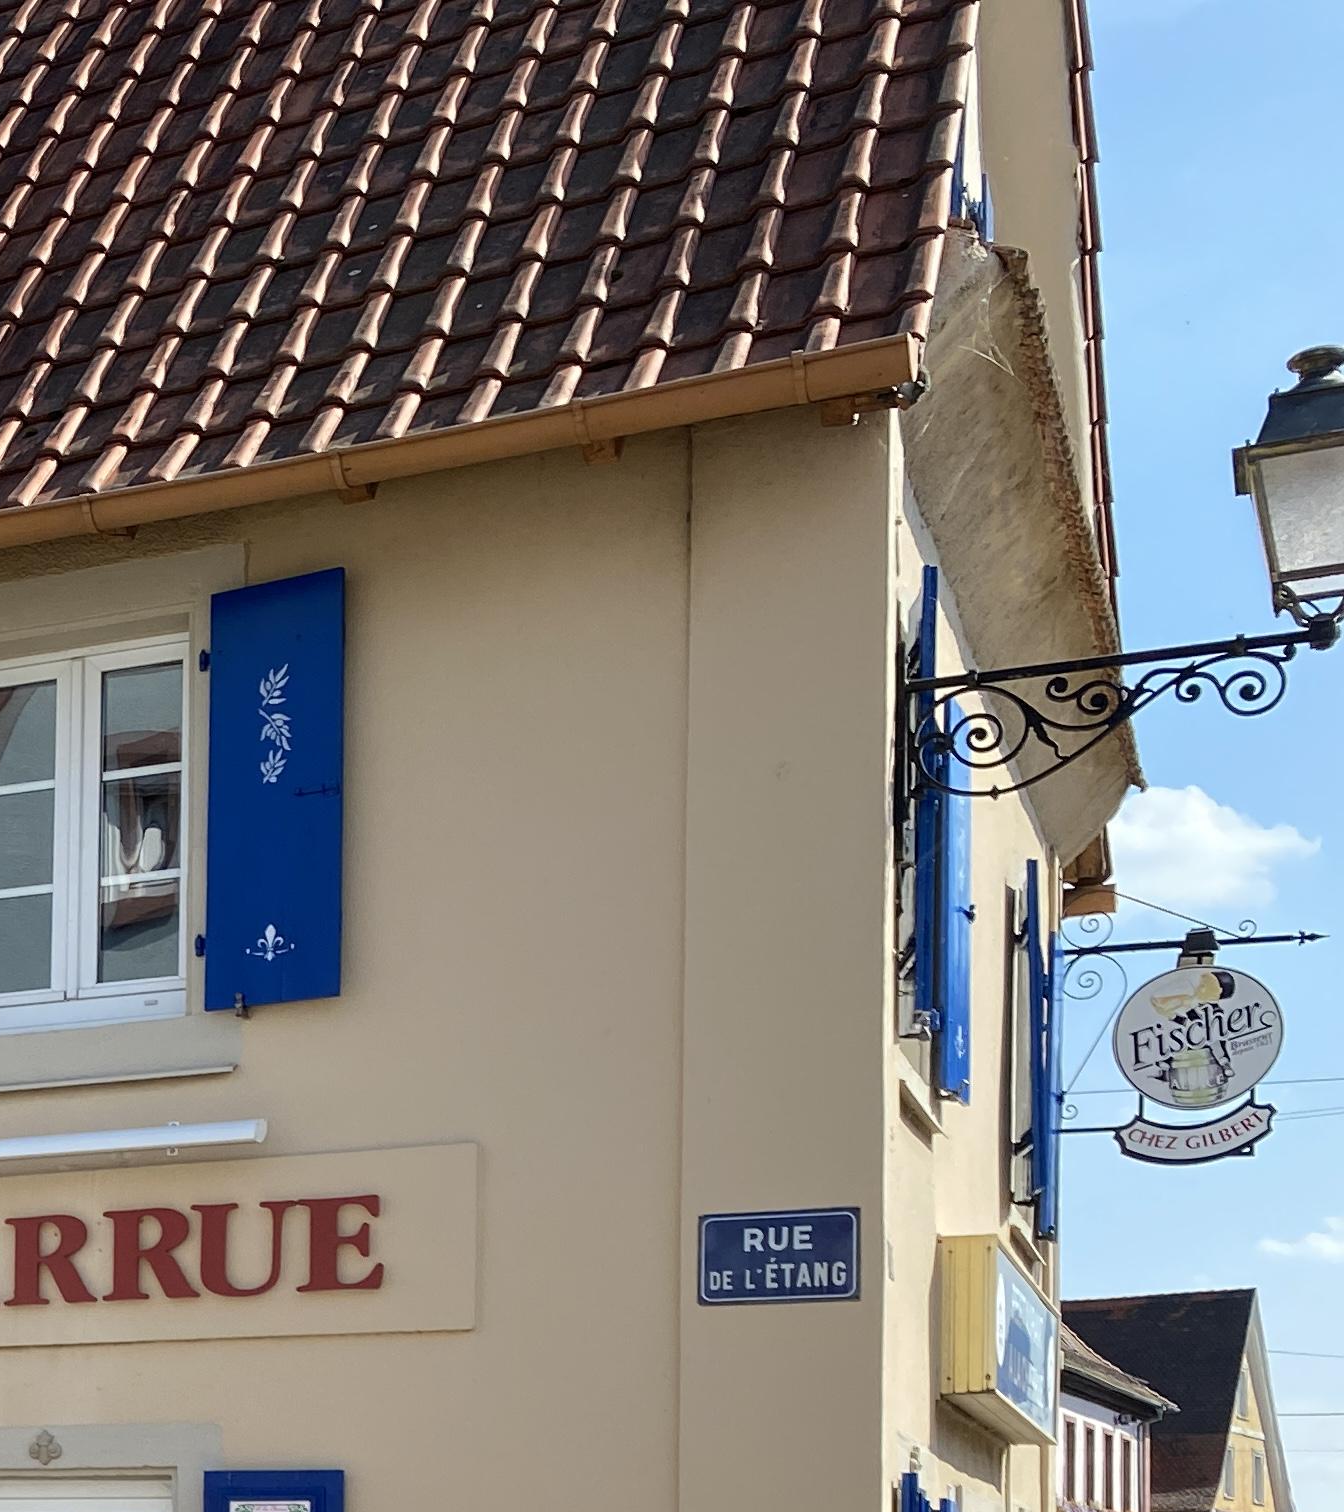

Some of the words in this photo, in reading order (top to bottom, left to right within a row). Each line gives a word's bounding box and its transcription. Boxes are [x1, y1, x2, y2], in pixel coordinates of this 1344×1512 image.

[1129, 1001, 1262, 1067] Fischer
[1128, 1128, 1177, 1150] CHEZ
[1186, 1111, 1265, 1149] GILBERT
[743, 1225, 813, 1252] RUE
[709, 1271, 733, 1291] DE
[745, 1257, 847, 1290] L'ÉTANG
